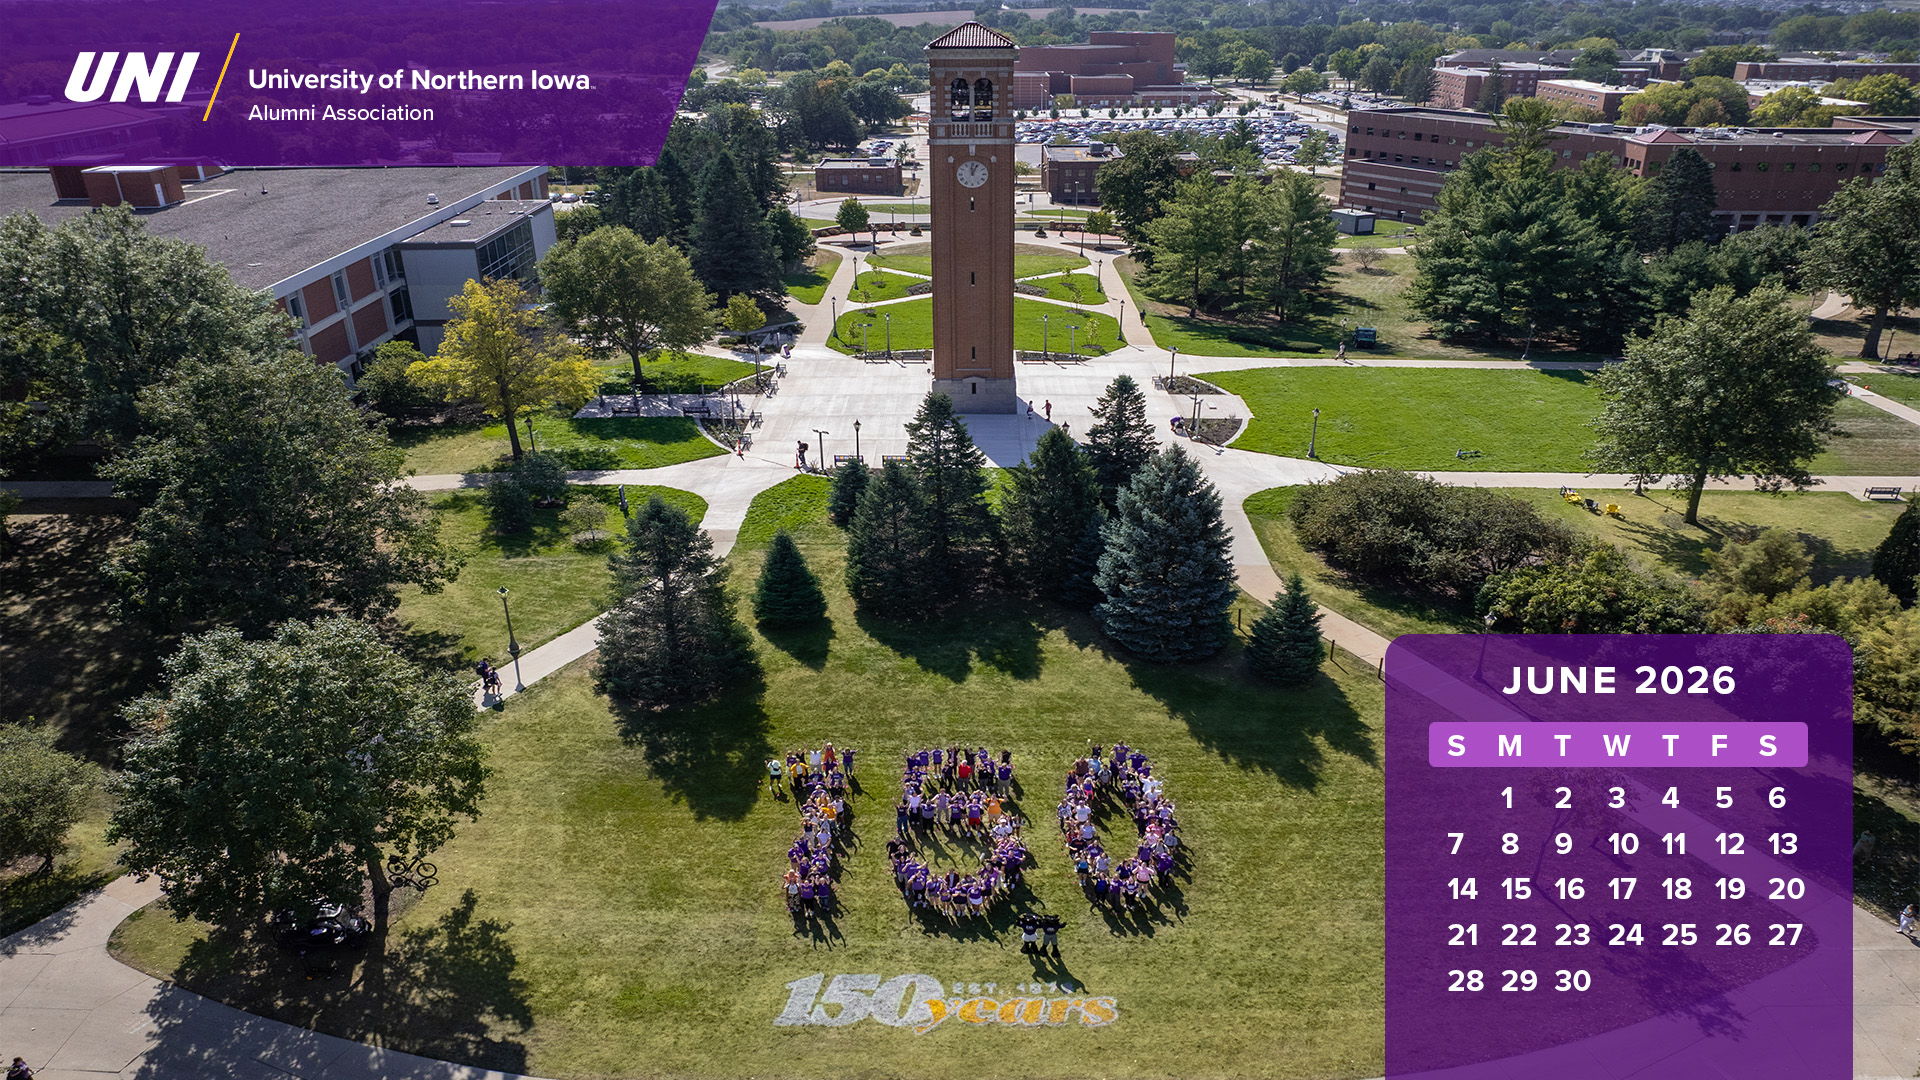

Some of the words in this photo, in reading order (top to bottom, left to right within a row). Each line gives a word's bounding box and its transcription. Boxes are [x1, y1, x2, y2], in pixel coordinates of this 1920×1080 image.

[773, 973, 944, 1027] 150
[952, 981, 1004, 995] EST.
[913, 997, 1119, 1035] years
